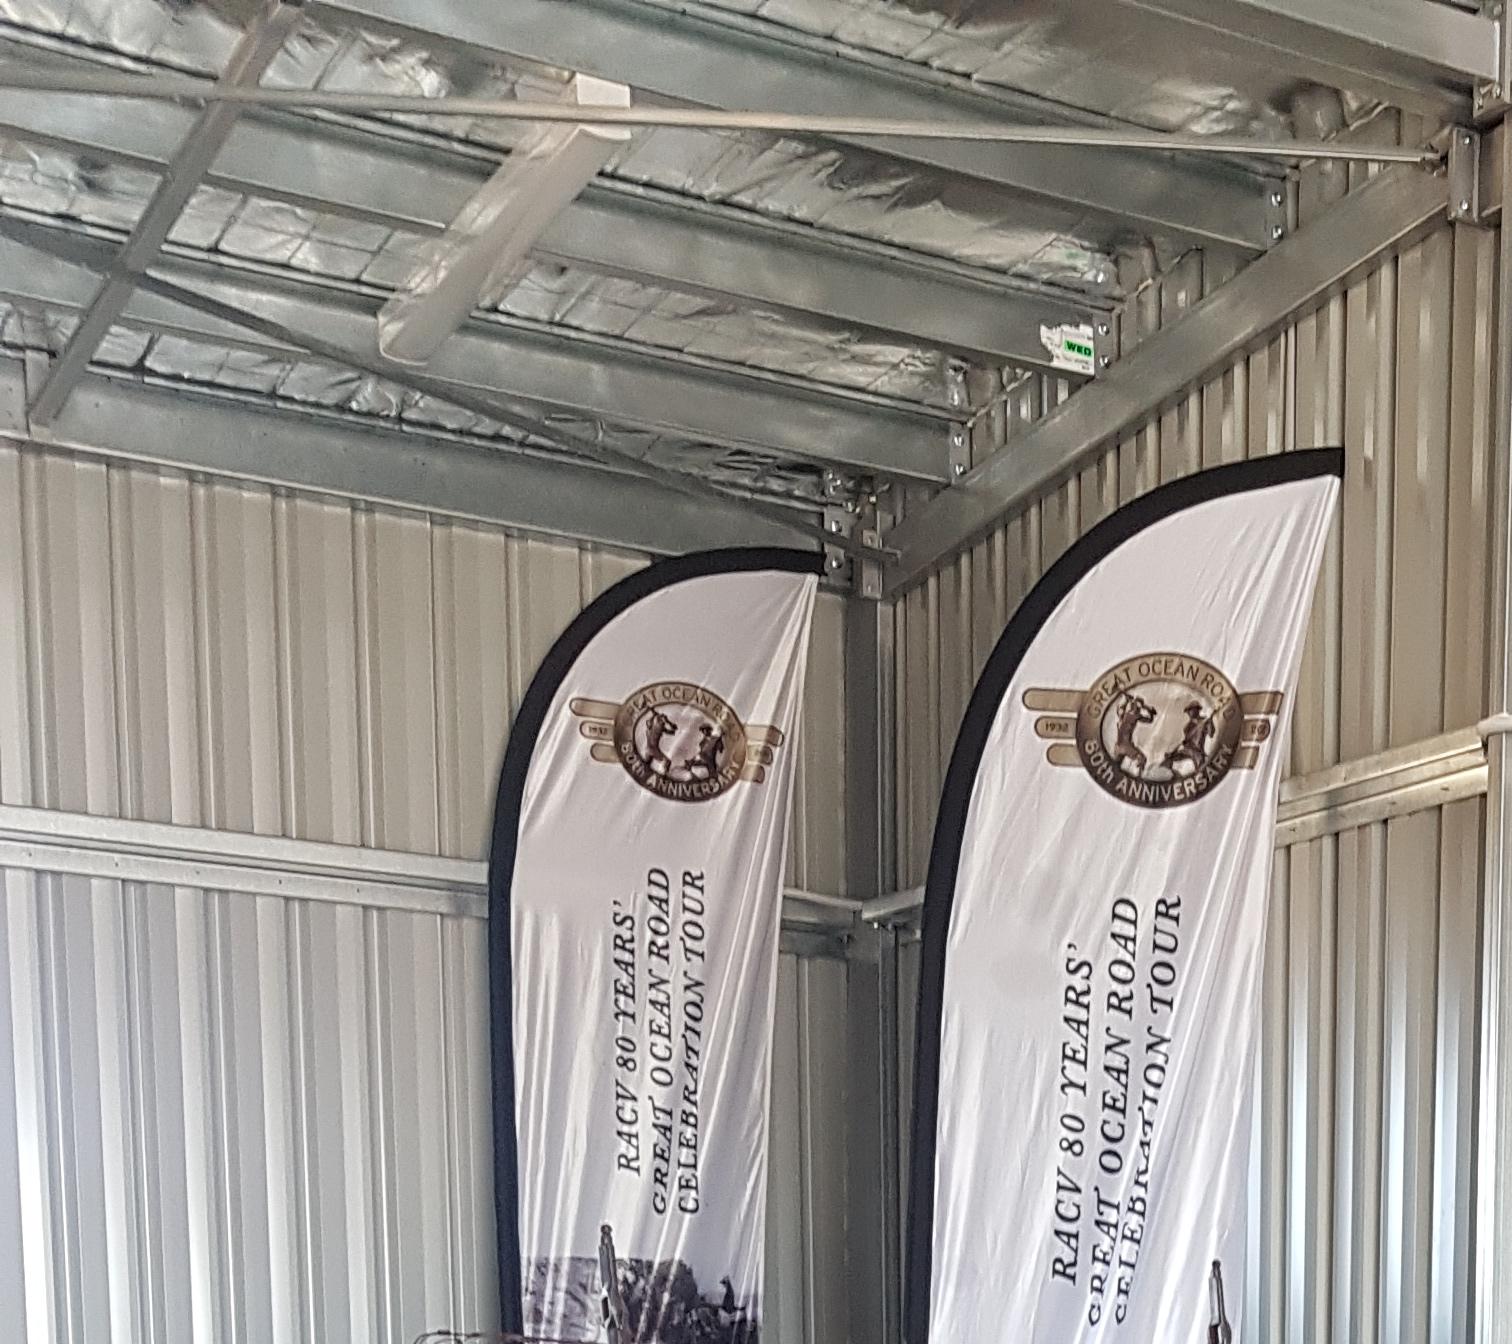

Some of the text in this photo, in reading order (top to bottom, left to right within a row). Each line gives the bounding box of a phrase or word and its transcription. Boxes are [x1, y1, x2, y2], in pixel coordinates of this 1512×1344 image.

[661, 685, 711, 707] OCEAN
[1086, 667, 1132, 719] GREAT
[1138, 656, 1200, 682] OCEAN
[645, 761, 740, 798] ANNIVERSARY
[1084, 739, 1233, 803] 80th ANNIVERSARY
[1145, 894, 1182, 1016] TOUR
[616, 1035, 637, 1072] 80
[647, 867, 674, 1216] GREAT OCEAN ROAD
[677, 869, 706, 1215] CELEBRATION TOUR
[615, 1077, 641, 1176] RACV
[1059, 1112, 1086, 1158] 80
[1088, 897, 1139, 1328] GREAT OCEAN ROAD
[1052, 1166, 1083, 1287] RACV
